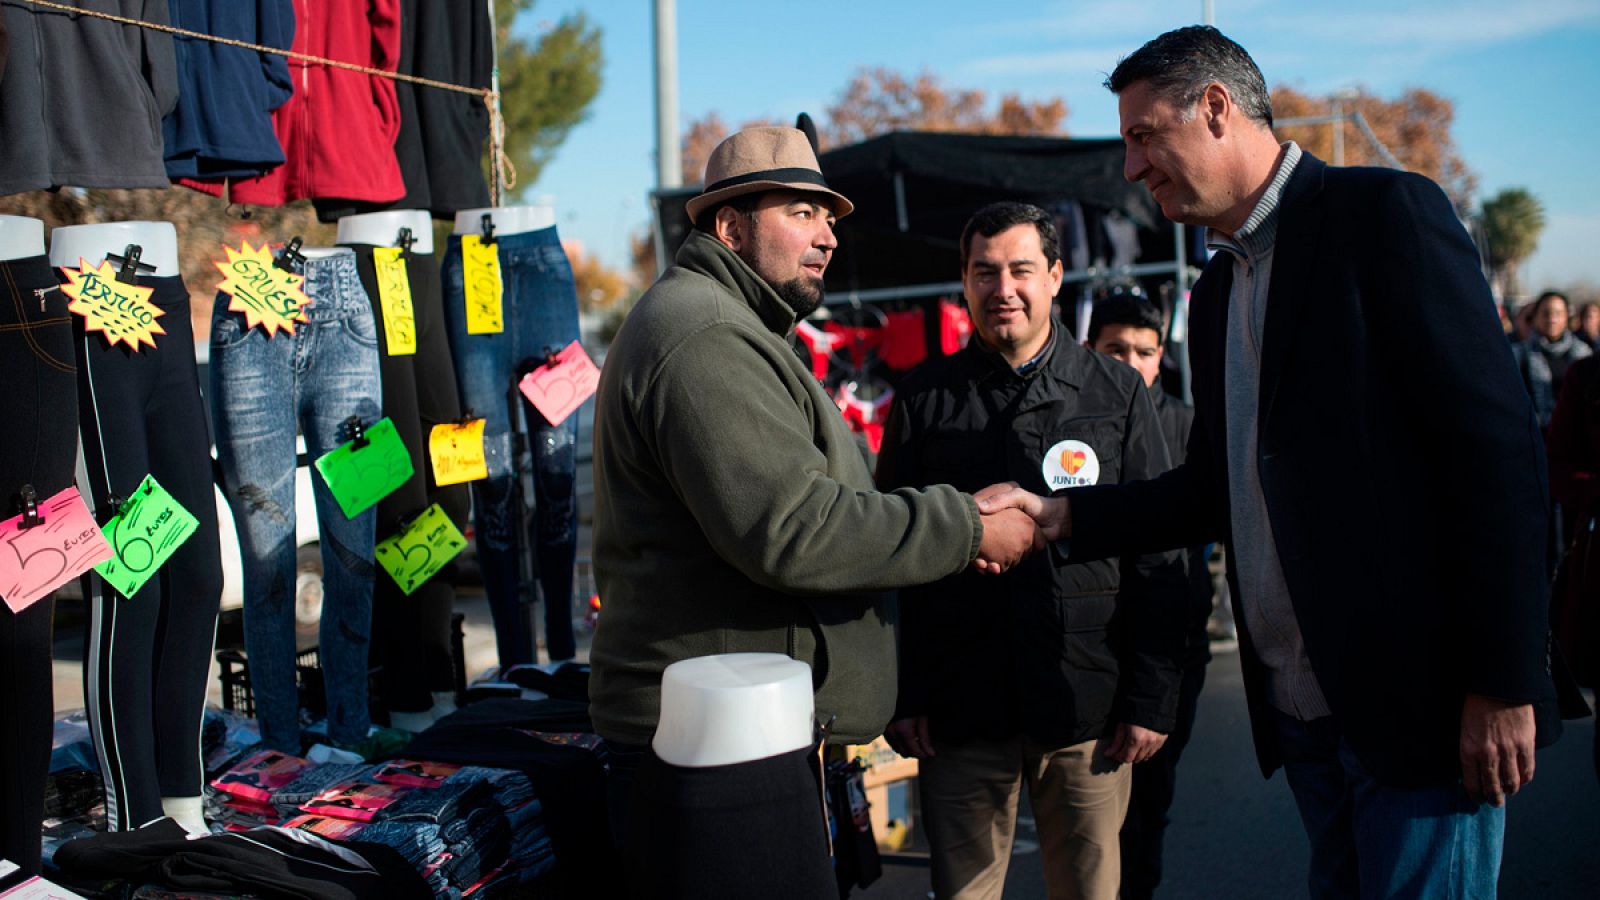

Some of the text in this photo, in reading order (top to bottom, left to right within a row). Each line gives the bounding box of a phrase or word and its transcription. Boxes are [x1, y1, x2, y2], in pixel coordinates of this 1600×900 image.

[231, 259, 301, 320] GRUESO
[532, 367, 576, 416] 5
[1053, 476, 1092, 486] JUNTOS
[7, 528, 68, 599] 5
[113, 514, 154, 573] 6
[393, 532, 432, 577] 5
